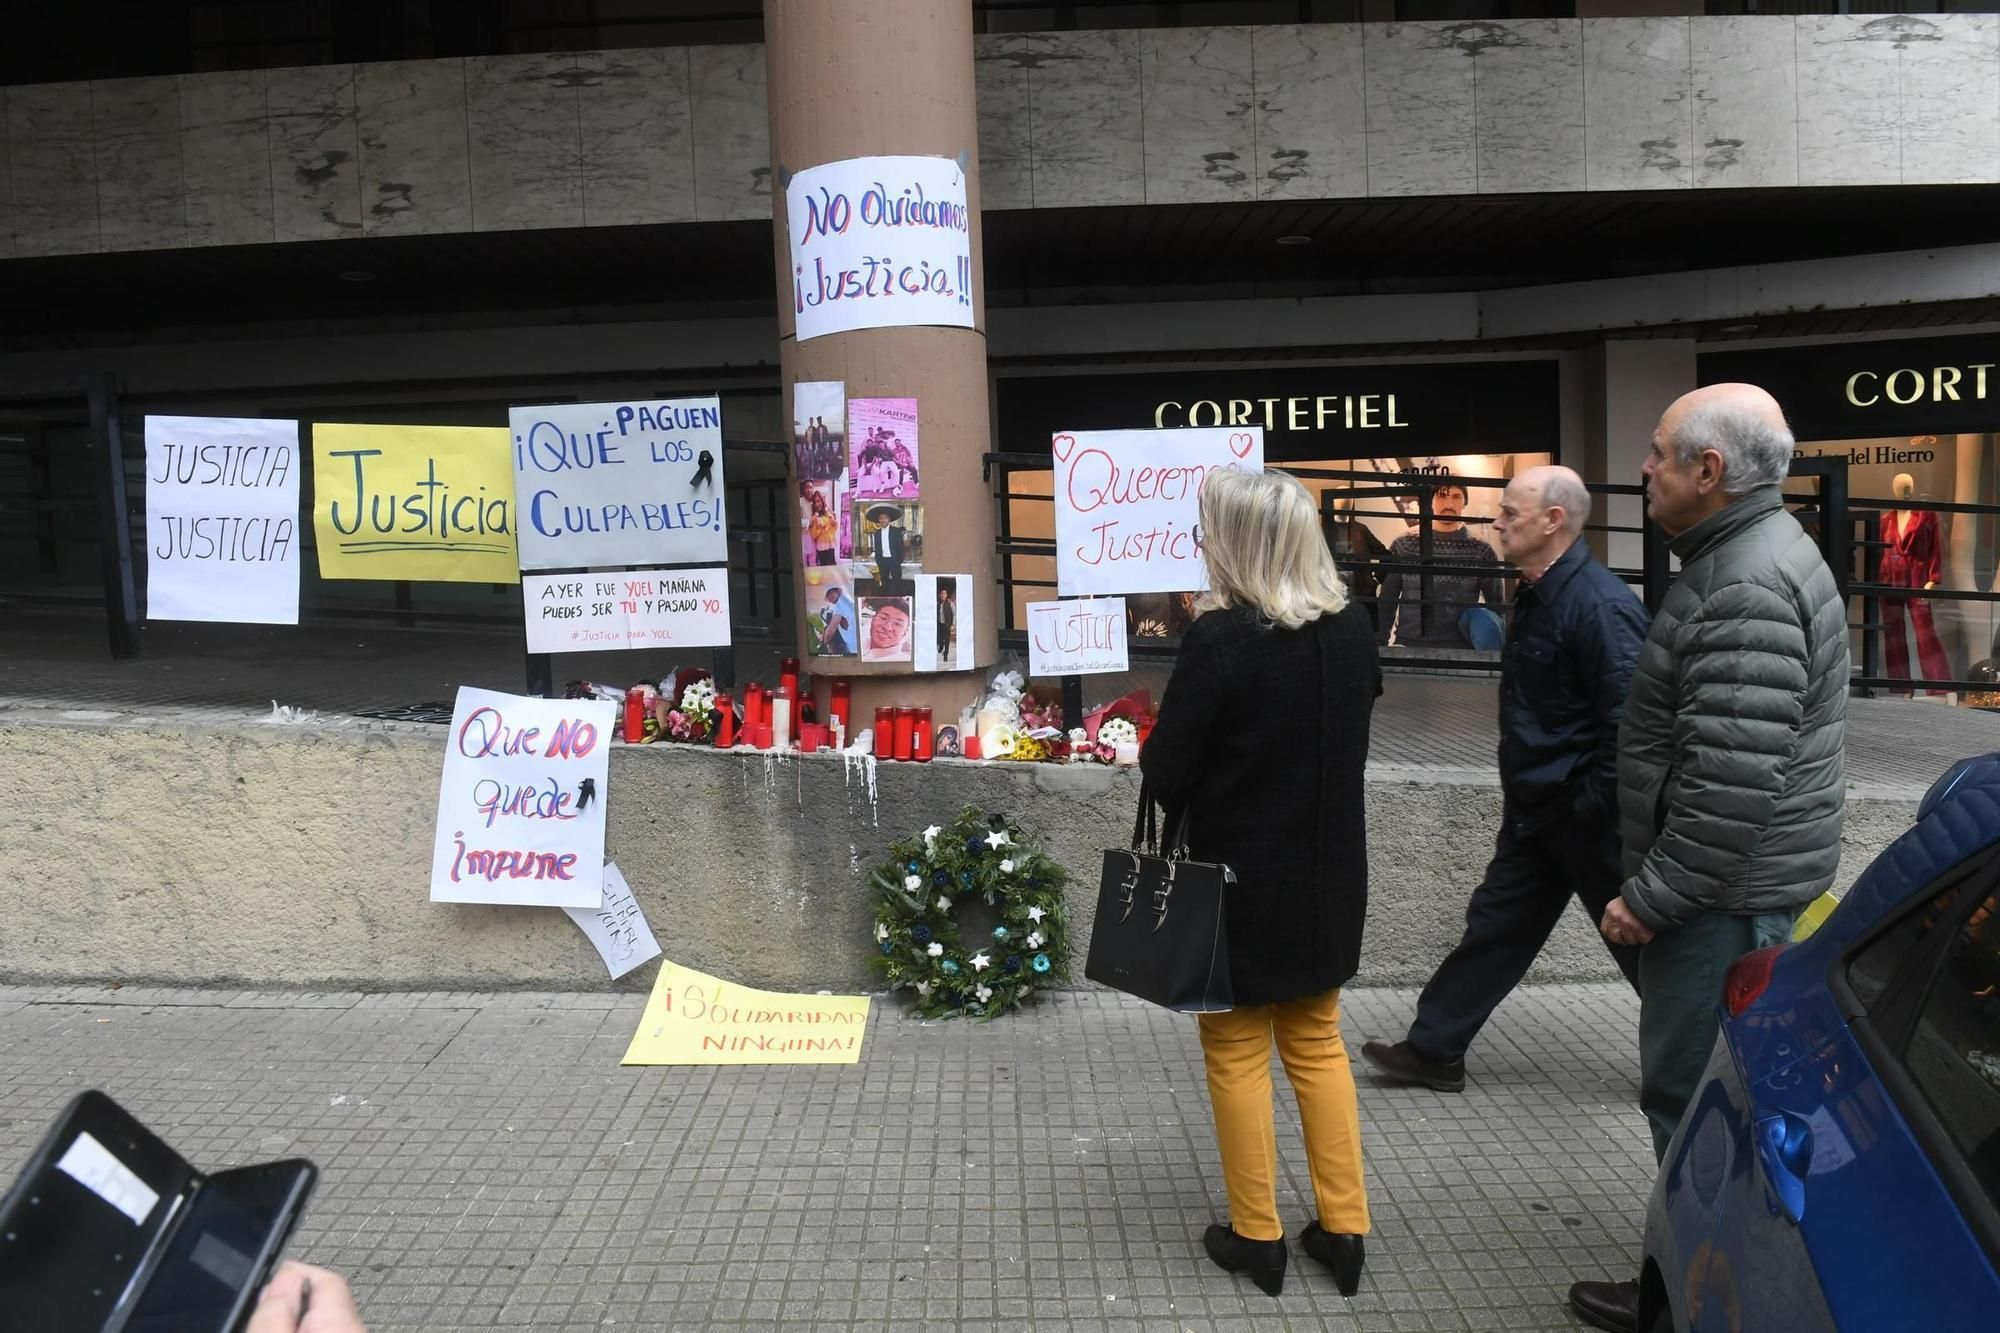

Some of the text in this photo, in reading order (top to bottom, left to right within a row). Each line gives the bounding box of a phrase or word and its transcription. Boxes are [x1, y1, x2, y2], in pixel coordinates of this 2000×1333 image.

[801, 182, 967, 246] NO Olvidamos
[616, 405, 719, 436] PAGUEN
[1154, 394, 1409, 431] CORTEFIEL
[153, 444, 291, 488] JUSTICIA
[651, 440, 694, 463] LOS
[1875, 446, 1935, 465] Hierro
[329, 449, 512, 538] Justicia
[1068, 448, 1236, 513] Querem
[531, 490, 720, 538] CULPABLES!
[156, 516, 293, 562] JUSTICIA
[541, 577, 706, 600] AYER FUE YOEL MAÑANA
[543, 605, 583, 619] PUEDES
[592, 602, 613, 617] SER
[620, 598, 637, 614] TÚ
[645, 600, 653, 613] Y
[657, 599, 697, 614] PASADO
[652, 630, 672, 640] YOEL
[459, 706, 598, 760] Que NO
[474, 777, 577, 828] quede
[703, 1034, 854, 1053] NINGUNA!
